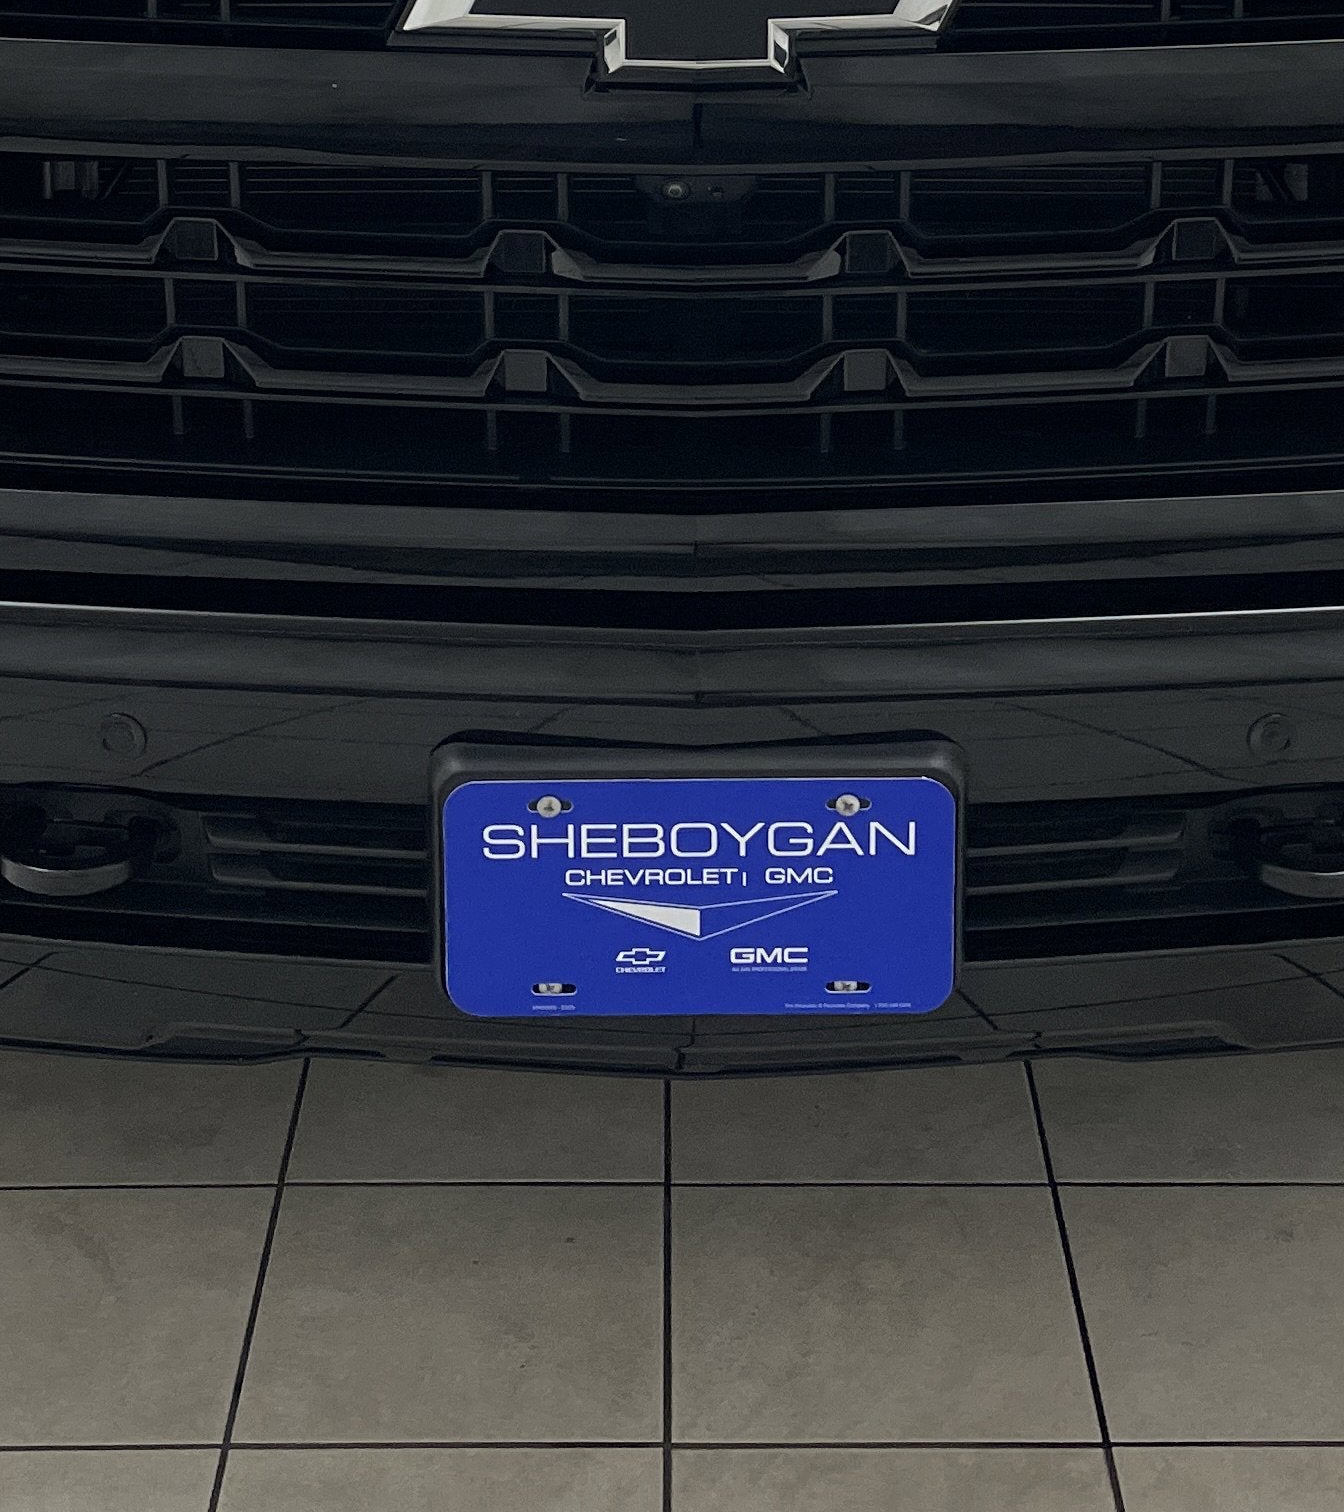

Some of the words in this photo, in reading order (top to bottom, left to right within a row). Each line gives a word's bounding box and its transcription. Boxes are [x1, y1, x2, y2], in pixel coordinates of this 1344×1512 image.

[482, 821, 916, 859] SHEBOYGAN
[564, 868, 739, 886] CHEVROLET
[765, 867, 834, 884] GMC
[729, 947, 809, 964] GMC
[615, 966, 667, 974] CHEVROLET
